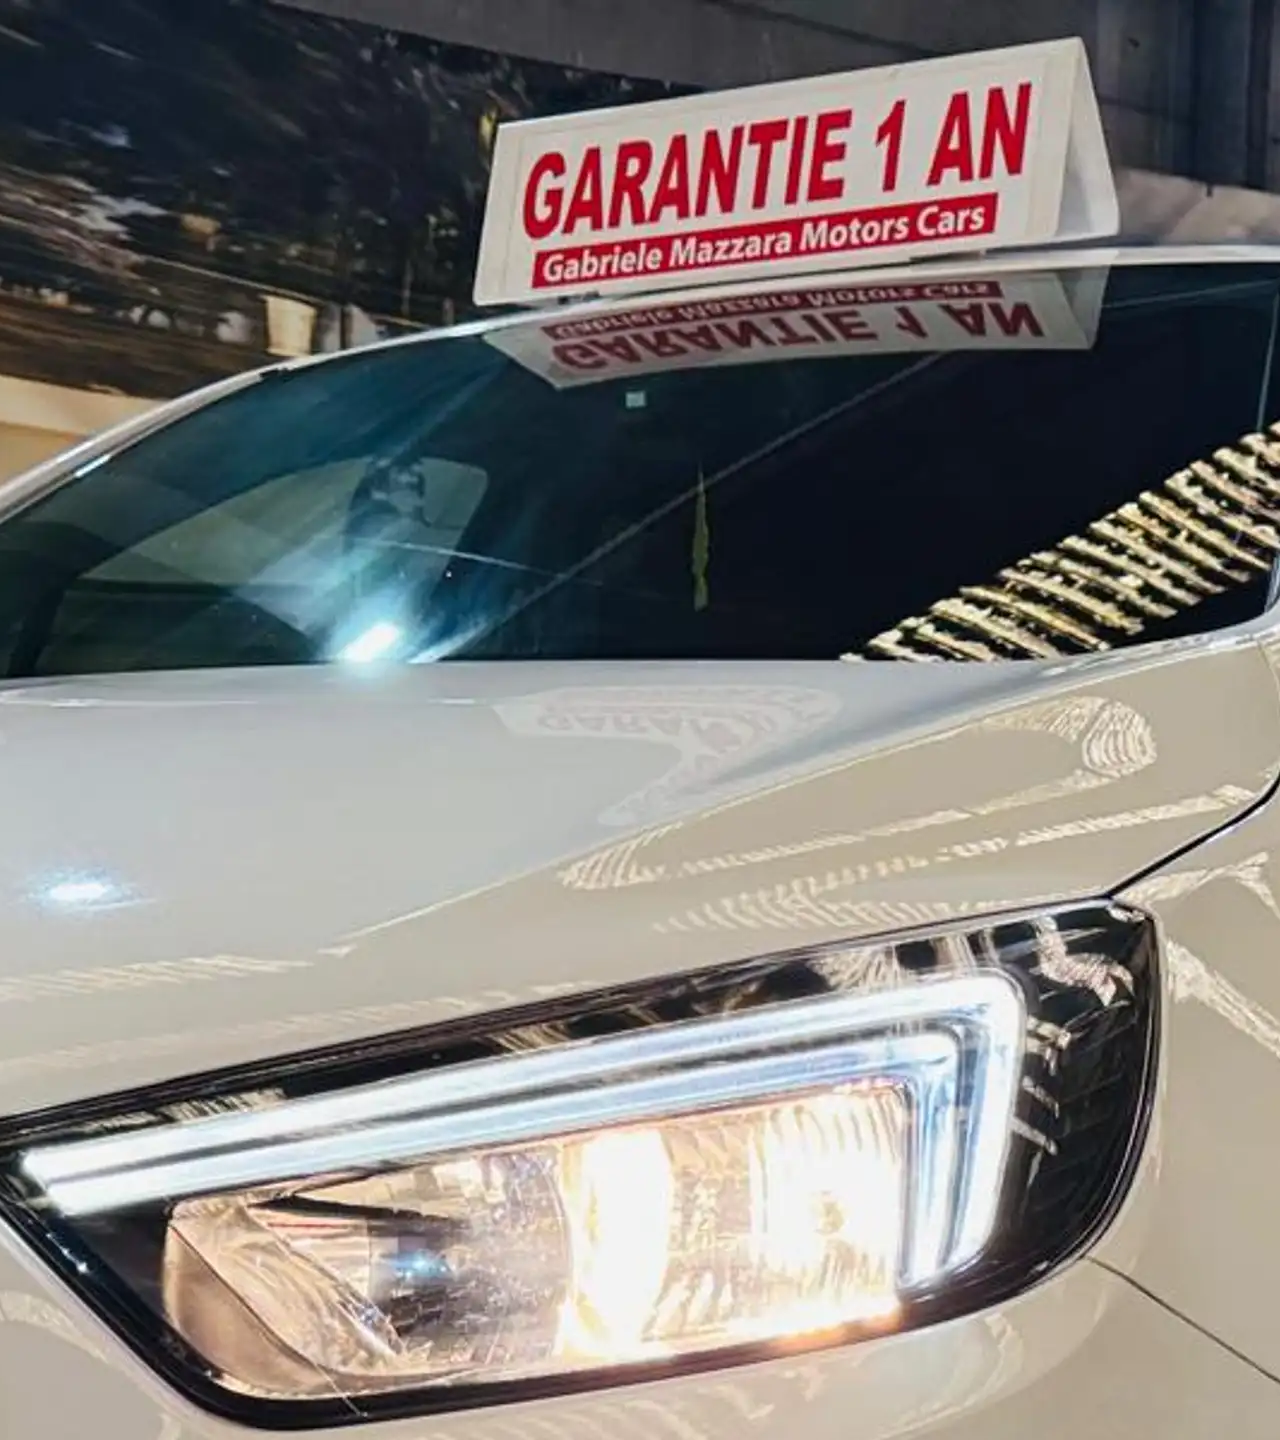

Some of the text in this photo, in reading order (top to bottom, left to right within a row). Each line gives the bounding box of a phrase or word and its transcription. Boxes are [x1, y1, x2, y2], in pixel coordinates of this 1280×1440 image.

[523, 82, 1033, 238] GARANTIE 1 AN
[542, 205, 985, 283] Gabriele Mazzara Motors Cars
